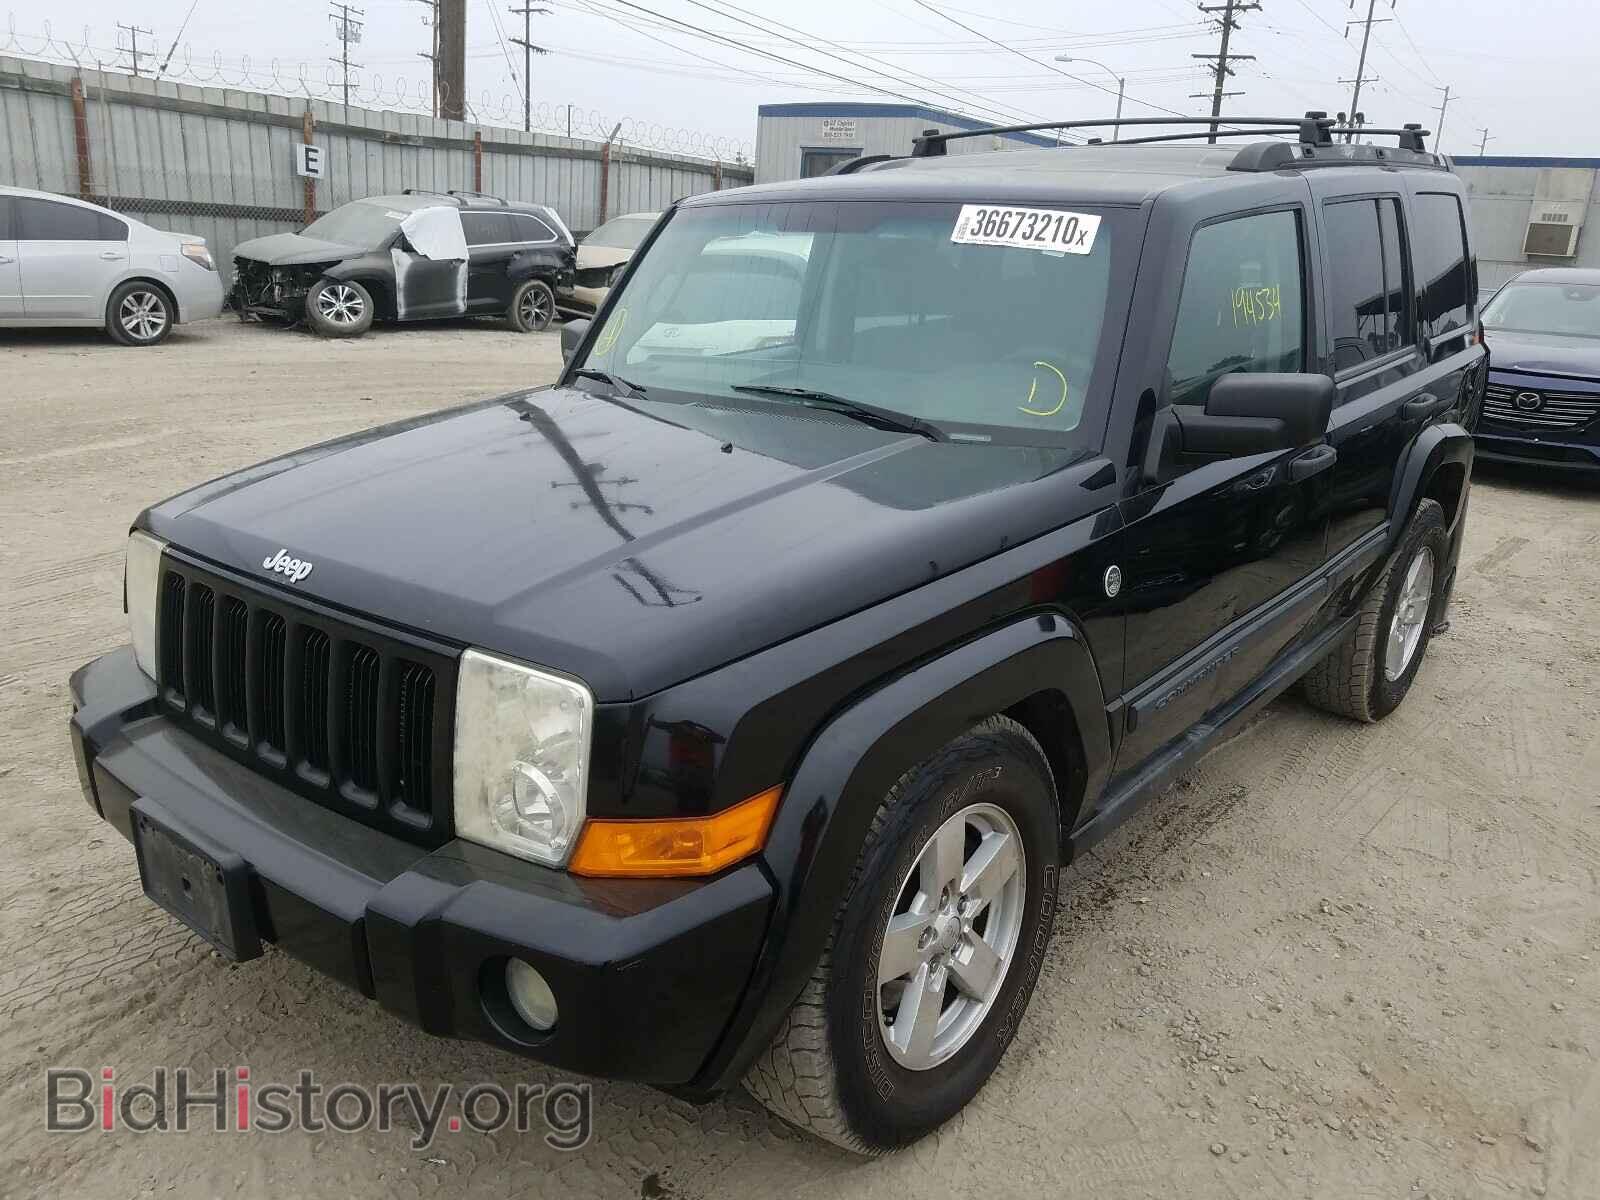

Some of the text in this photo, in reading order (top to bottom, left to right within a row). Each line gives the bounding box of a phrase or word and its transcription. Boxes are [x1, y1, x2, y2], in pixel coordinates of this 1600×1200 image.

[305, 147, 319, 174] E
[1016, 361, 1067, 416] D
[262, 548, 313, 584] Jeep
